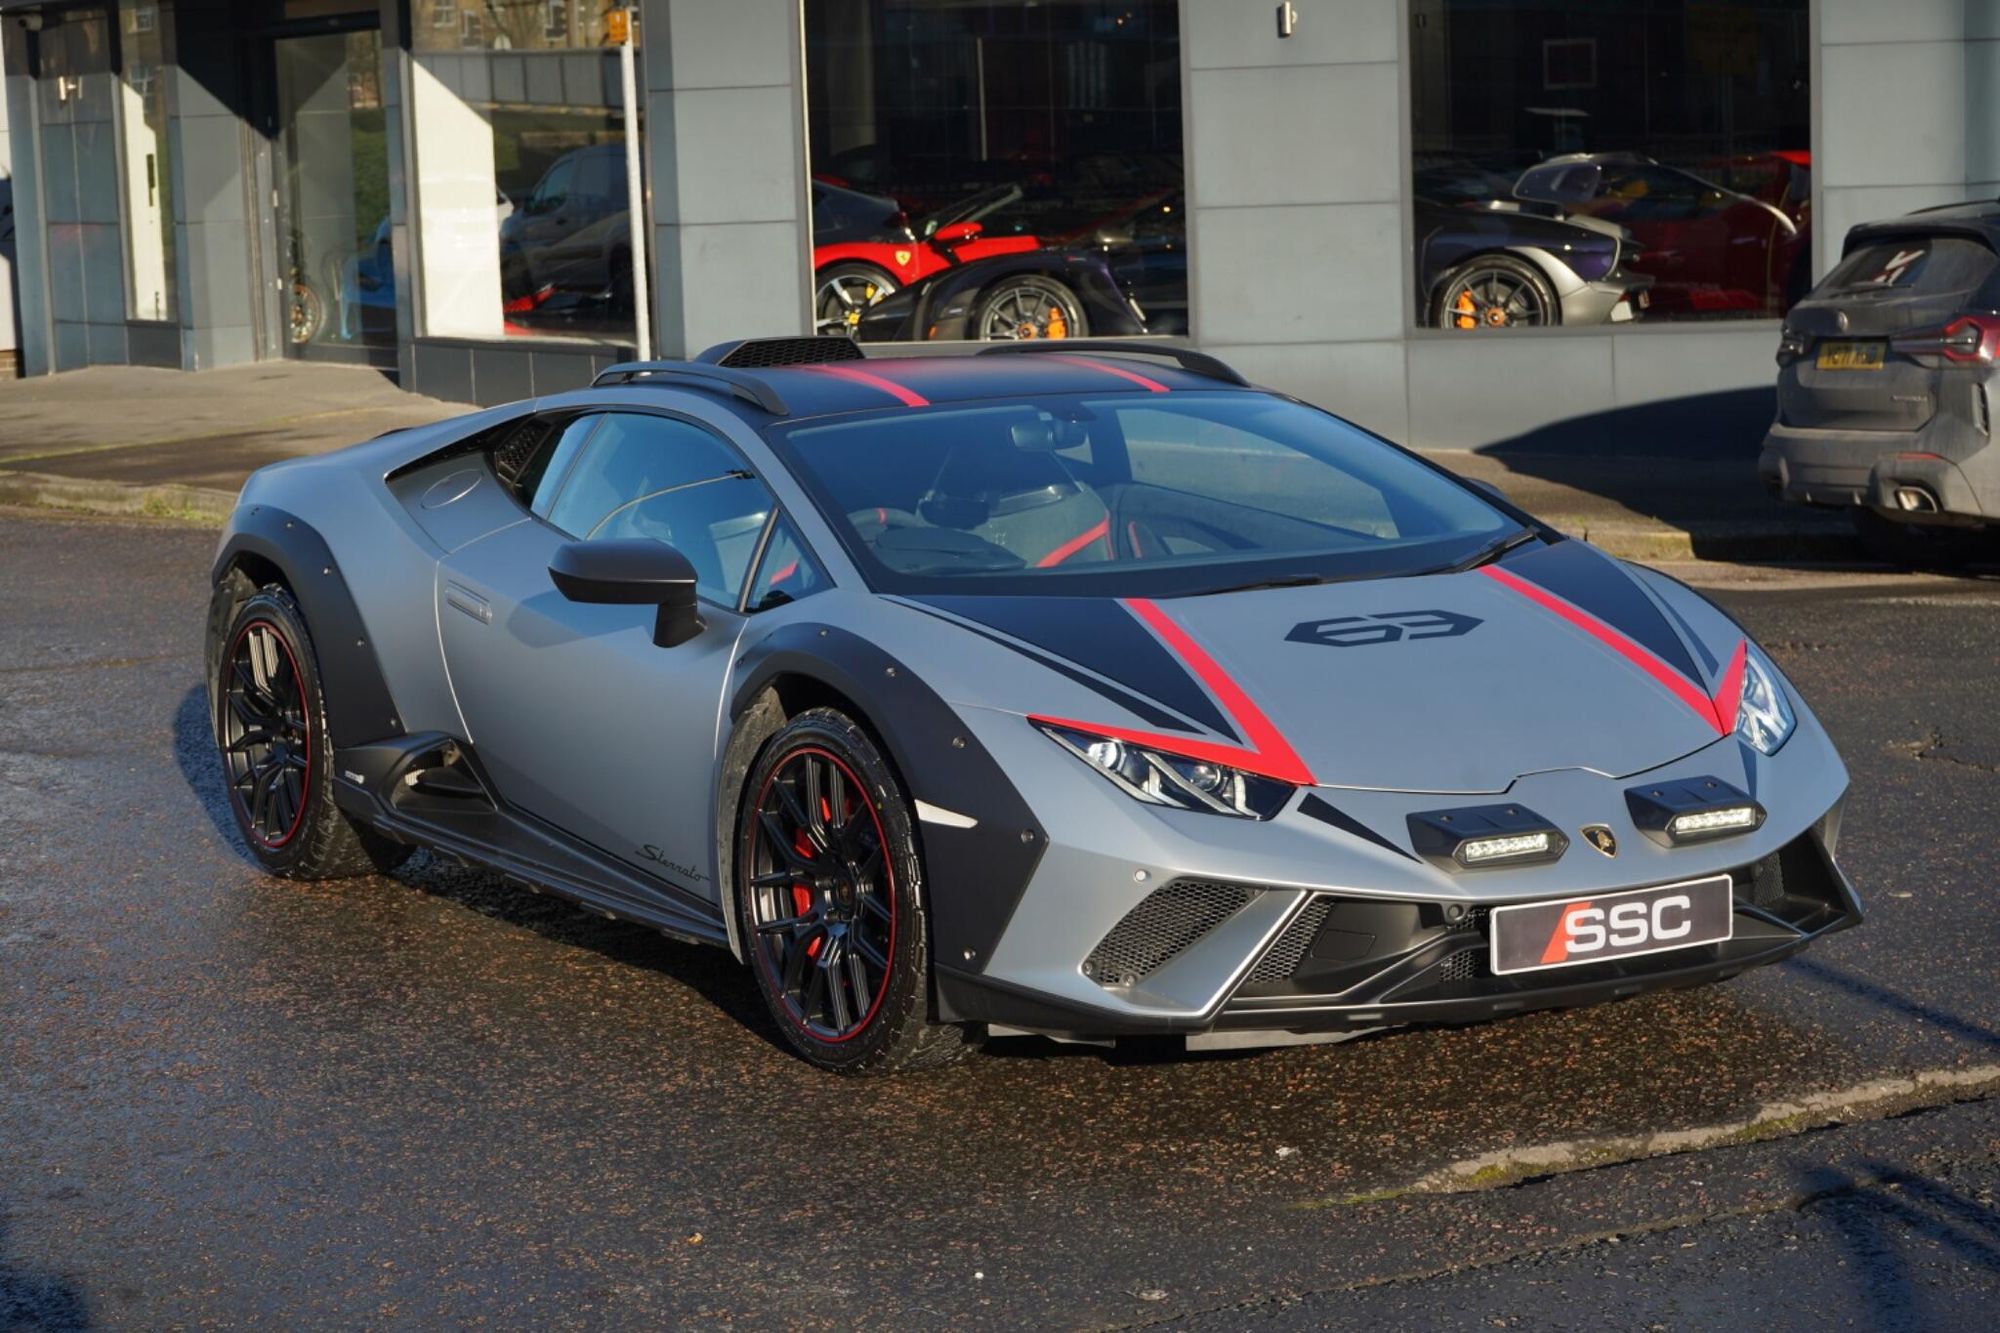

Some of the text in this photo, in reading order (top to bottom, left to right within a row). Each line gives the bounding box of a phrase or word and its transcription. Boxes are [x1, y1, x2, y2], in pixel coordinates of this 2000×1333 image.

[1284, 609, 1486, 648] 63
[635, 843, 712, 882] Sterrato
[1564, 895, 1692, 953] SSC
